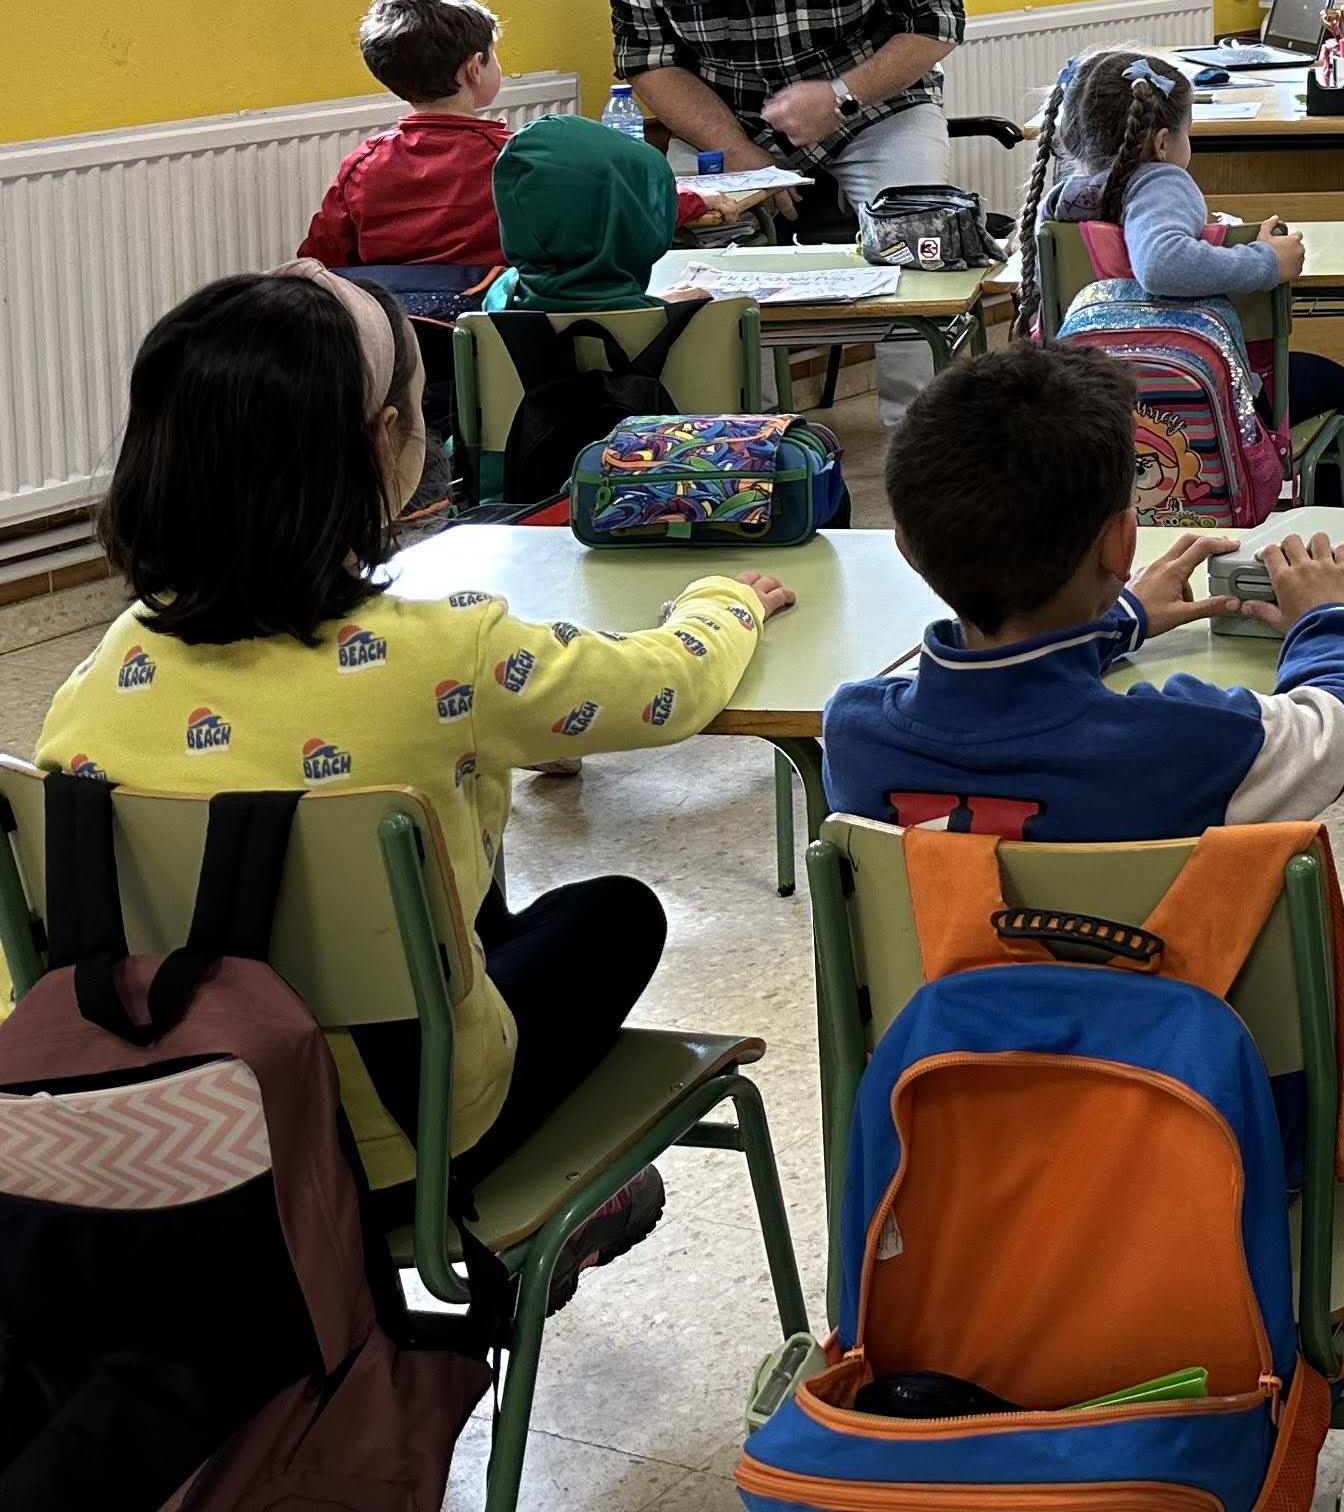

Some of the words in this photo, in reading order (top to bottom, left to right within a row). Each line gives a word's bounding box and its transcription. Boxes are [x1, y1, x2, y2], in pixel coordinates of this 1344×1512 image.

[338, 640, 387, 667] BEACH
[118, 664, 156, 688] BEACH
[505, 649, 536, 694] BEACH
[651, 687, 676, 726] BEACH
[186, 724, 232, 750] BEACH
[303, 754, 352, 780] BEACH
